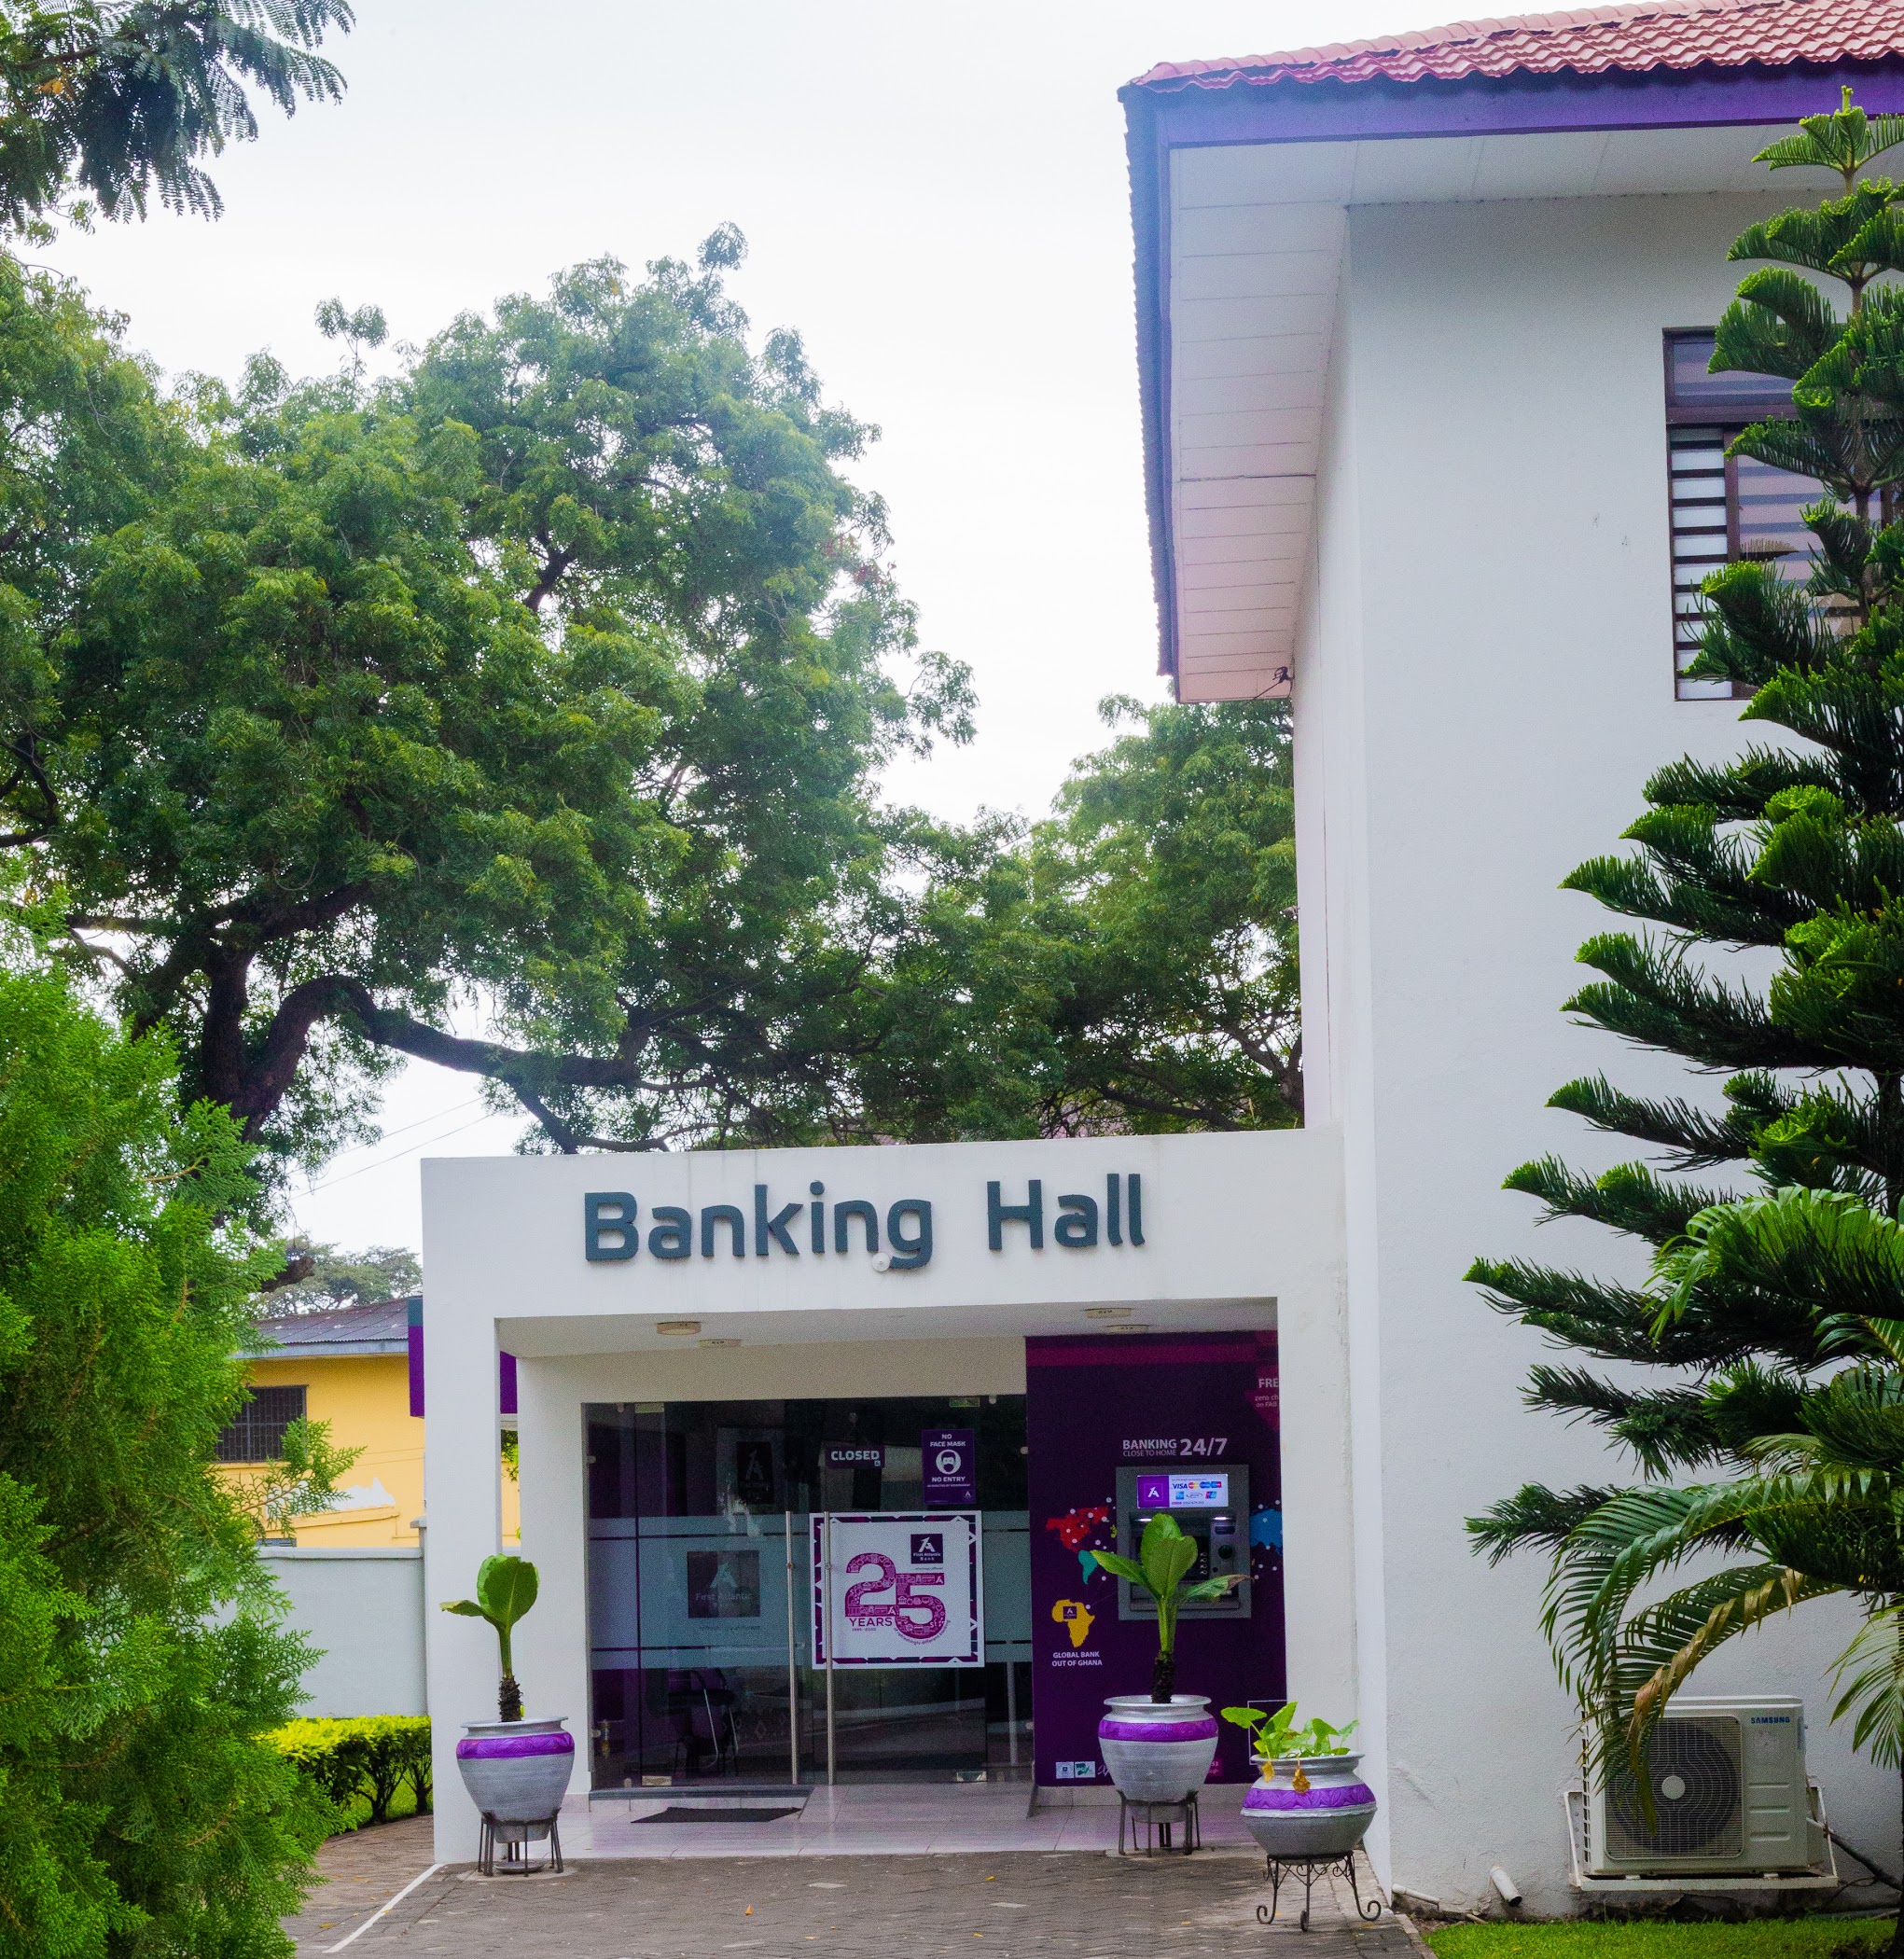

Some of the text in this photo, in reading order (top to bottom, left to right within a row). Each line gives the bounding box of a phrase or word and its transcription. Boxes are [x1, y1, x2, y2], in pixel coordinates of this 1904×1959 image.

[584, 1173, 1146, 1270] Banking Hall
[830, 1450, 880, 1461] CLOSED
[1122, 1437, 1228, 1456] BANKING 24/7
[844, 1552, 946, 1640] 25
[849, 1617, 893, 1627] YEARS
